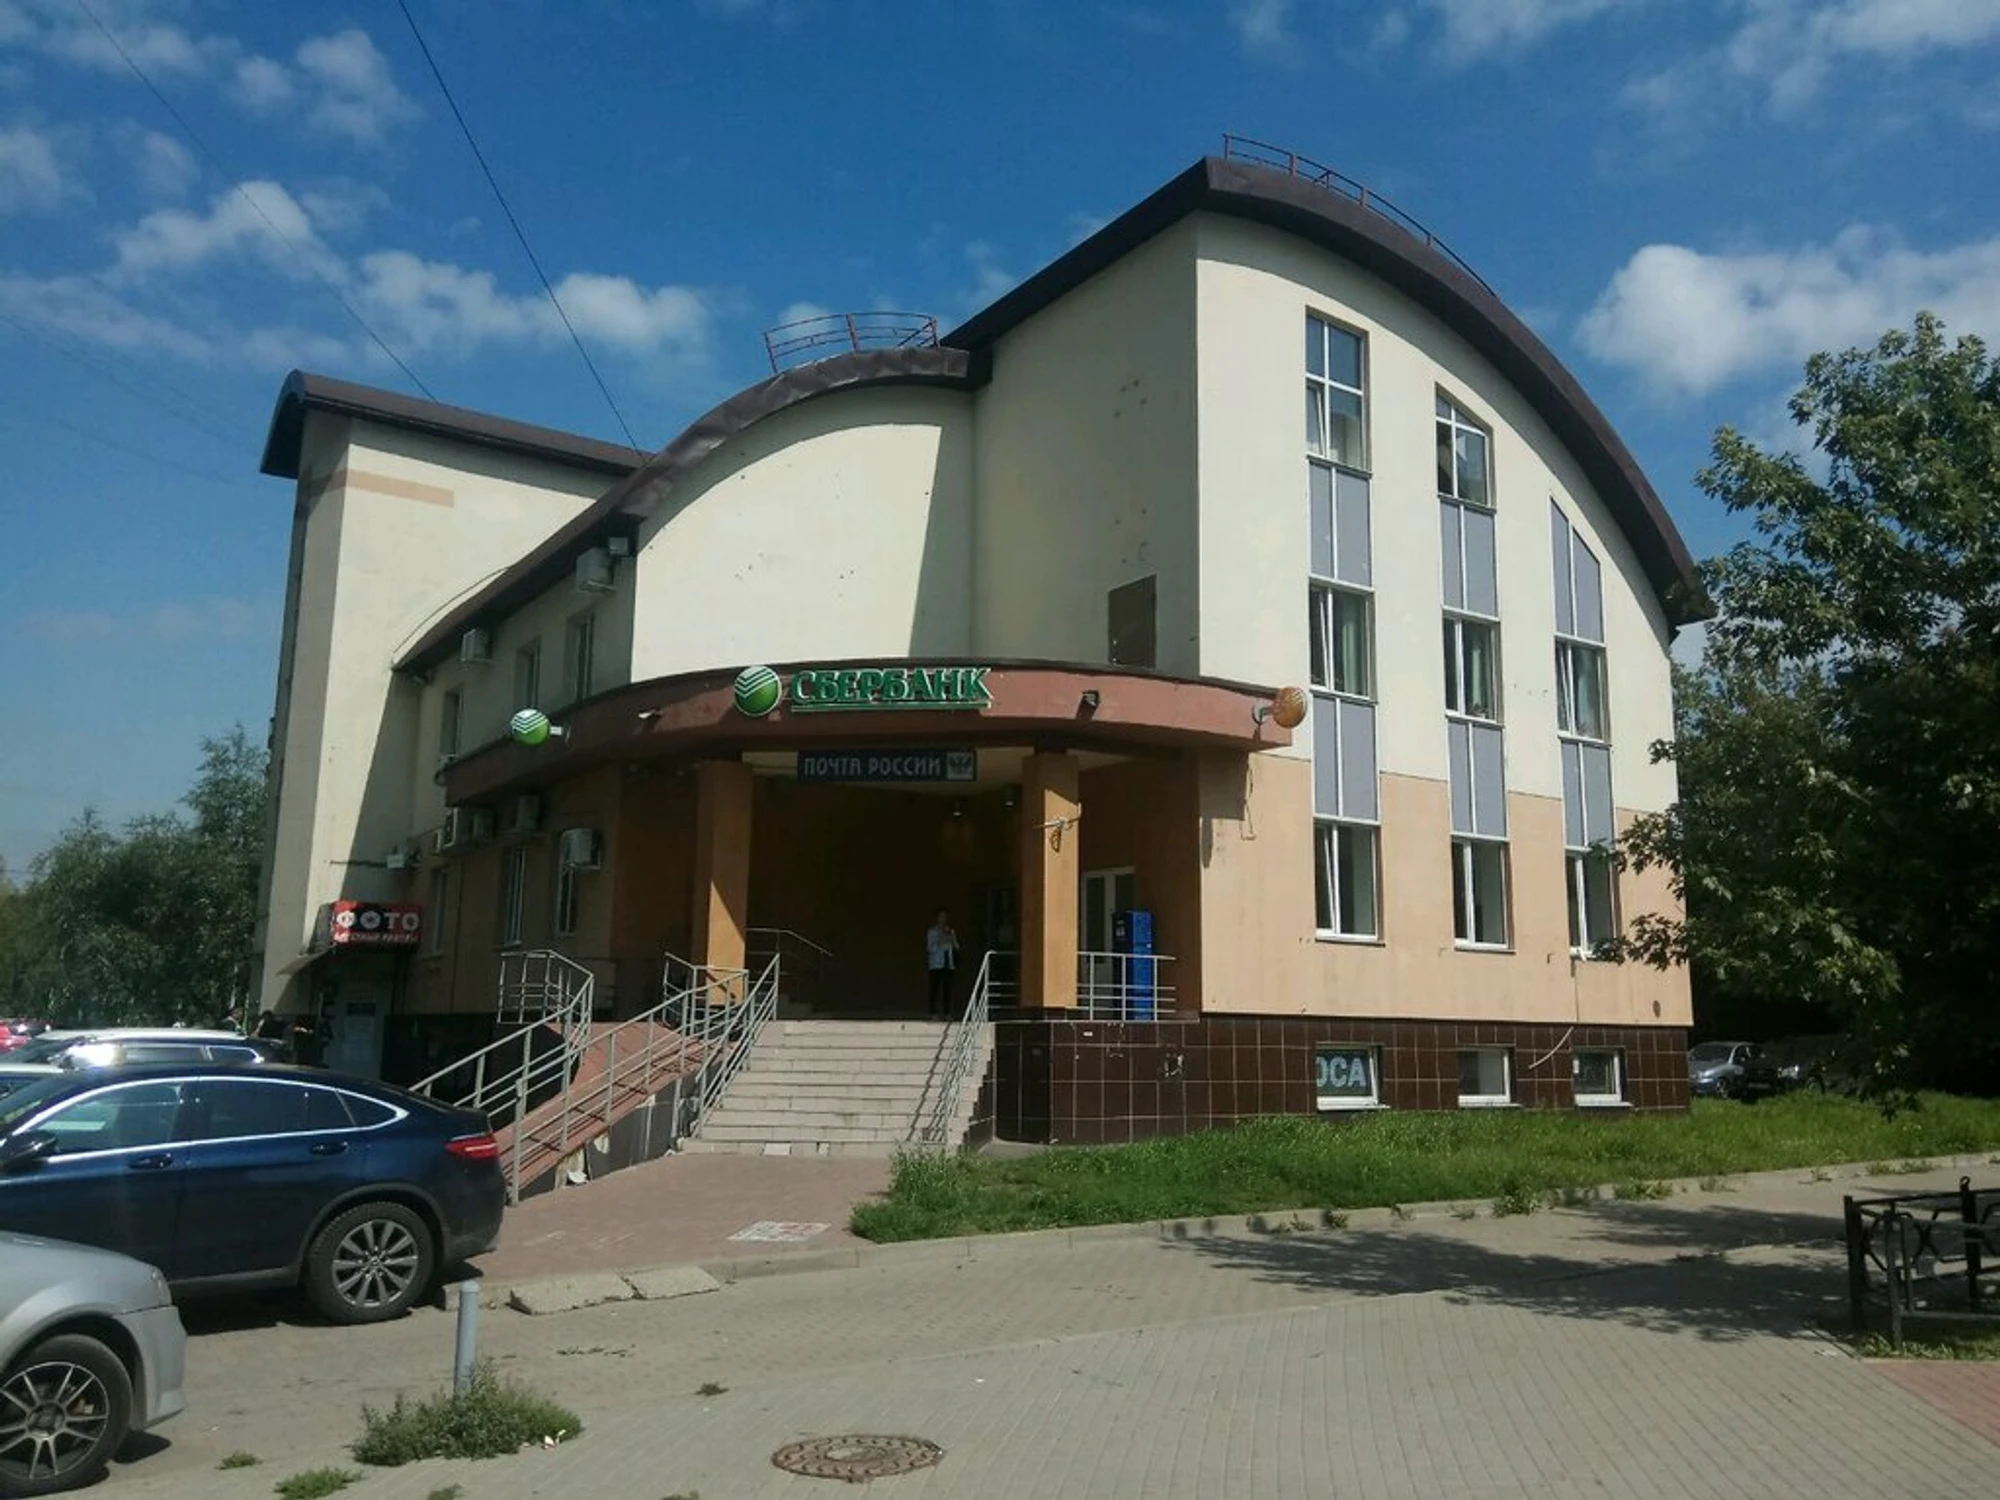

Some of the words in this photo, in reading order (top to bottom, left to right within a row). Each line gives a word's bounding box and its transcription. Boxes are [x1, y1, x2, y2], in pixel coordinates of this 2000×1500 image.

[790, 667, 991, 704] СБЕРБАНК
[804, 757, 863, 778] ПОЧТА
[868, 756, 942, 777] РОССИИ
[336, 910, 420, 932] ФОТО
